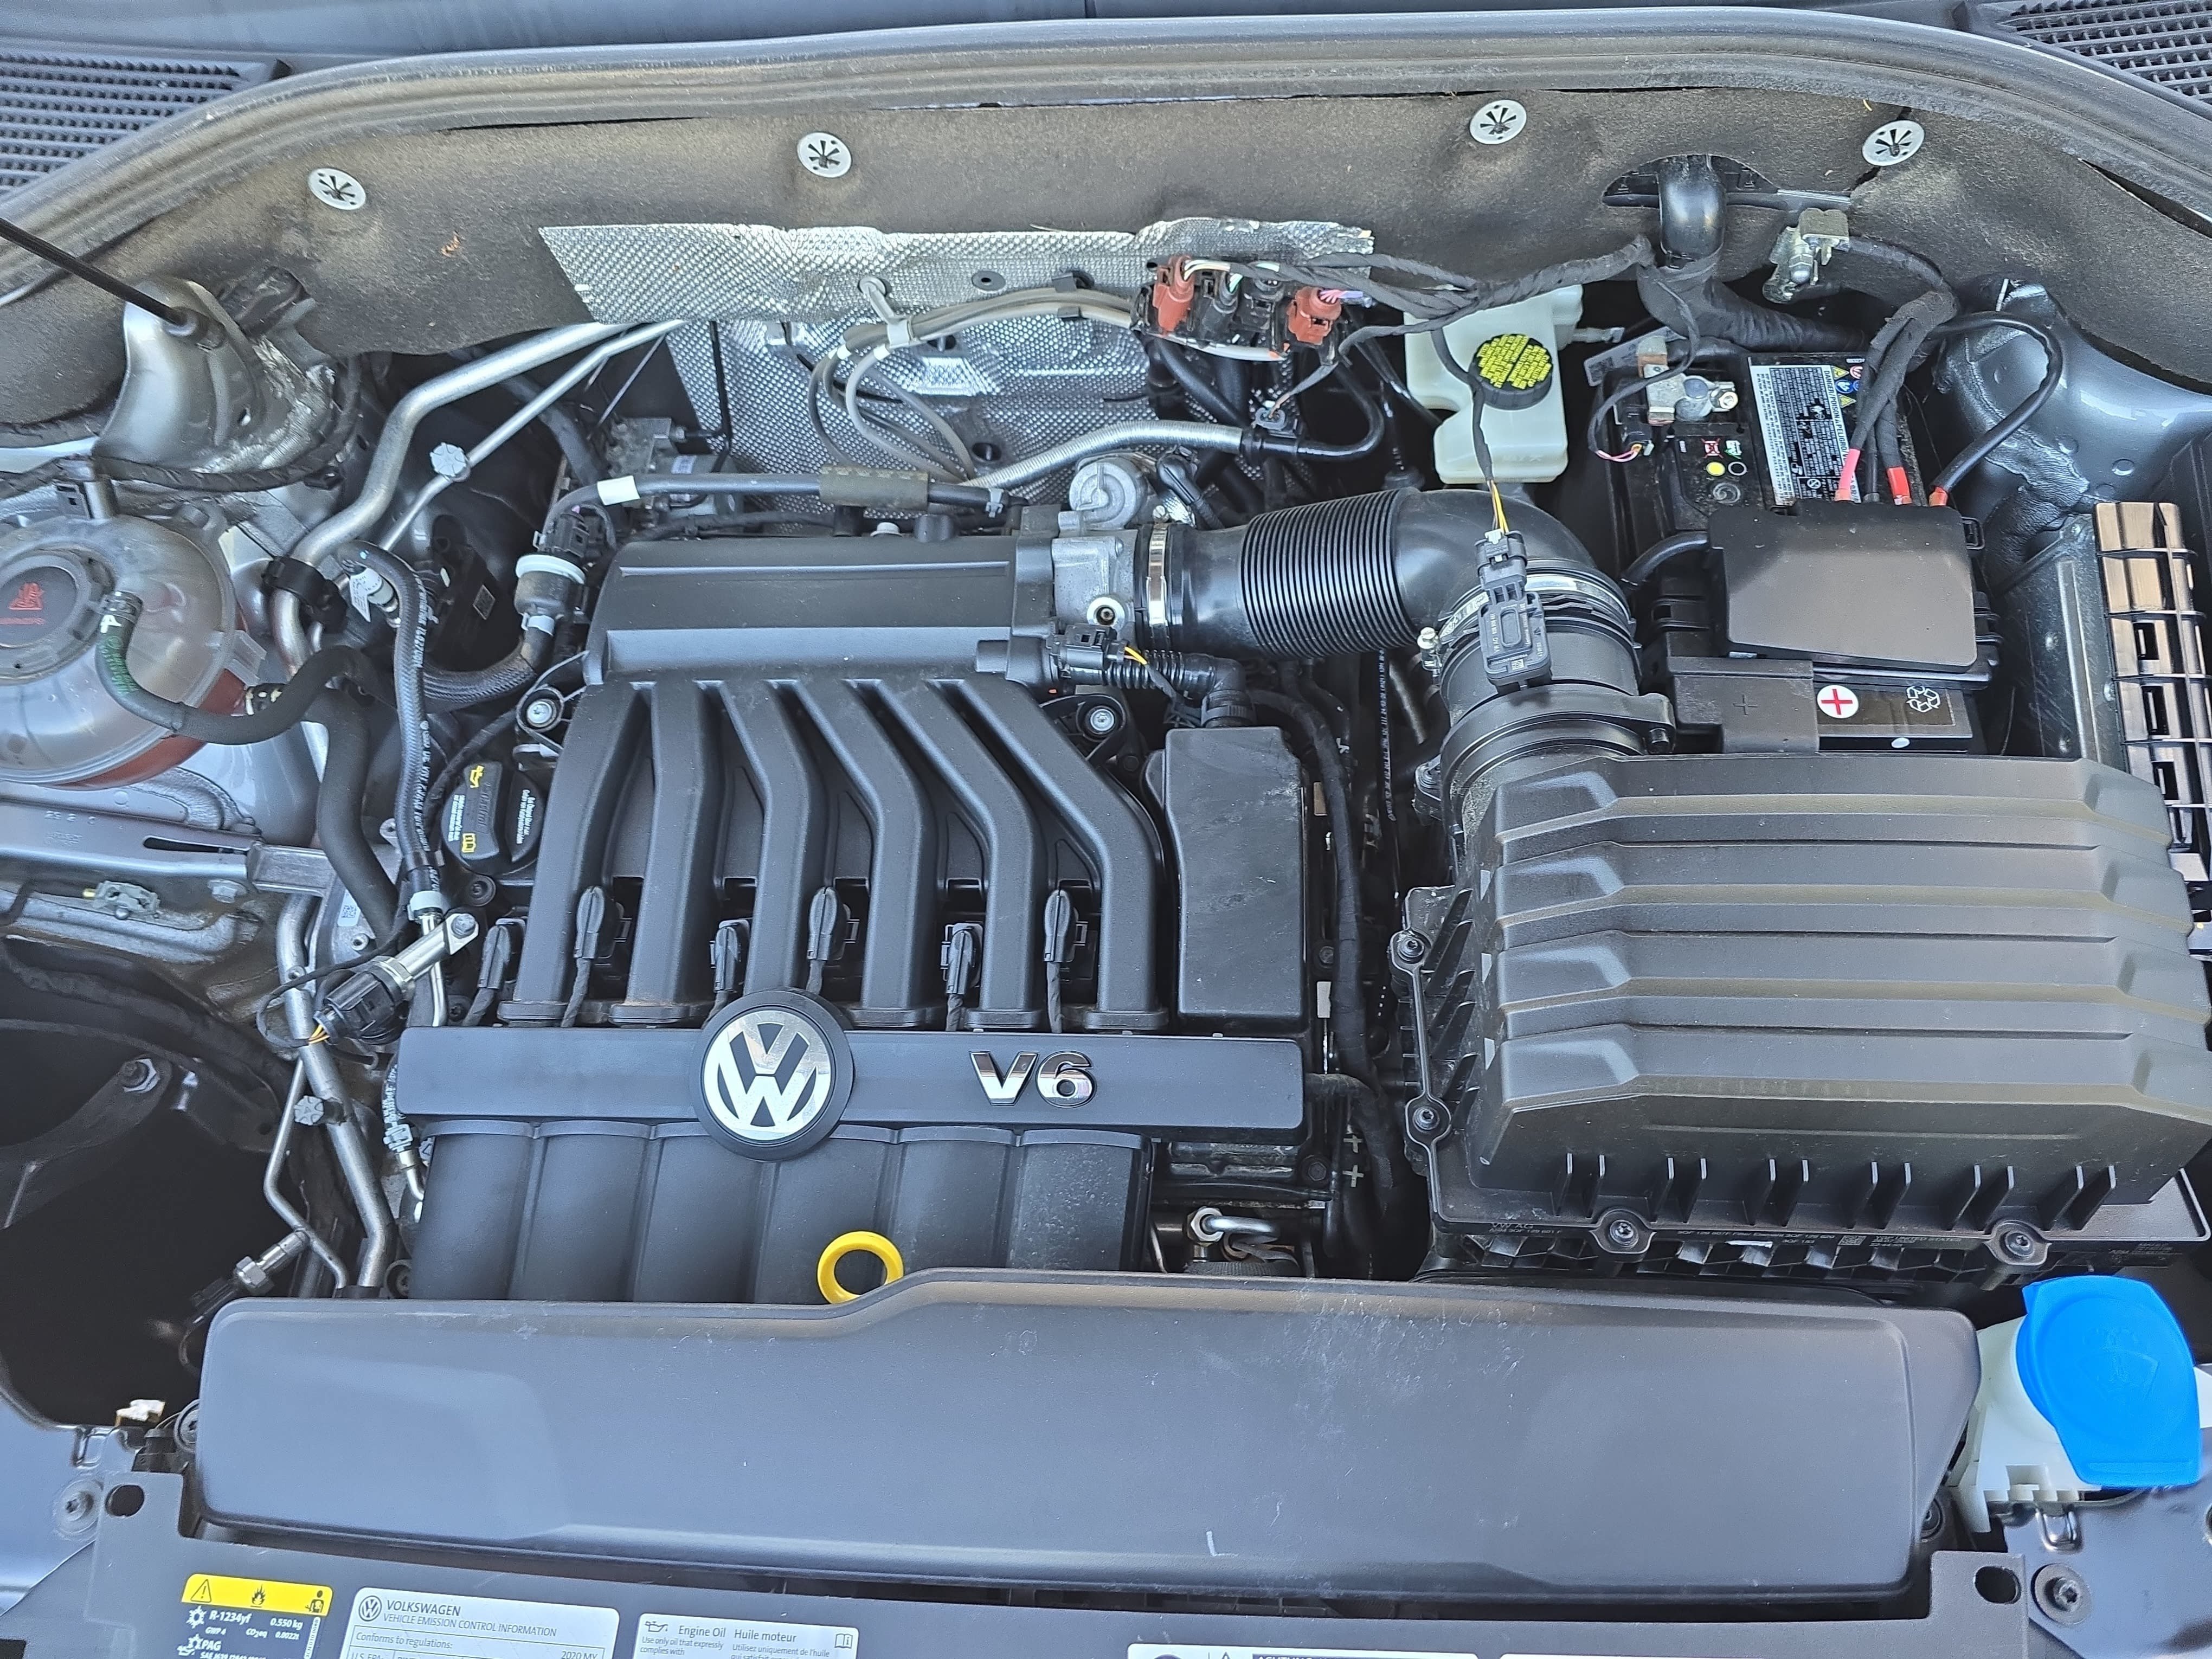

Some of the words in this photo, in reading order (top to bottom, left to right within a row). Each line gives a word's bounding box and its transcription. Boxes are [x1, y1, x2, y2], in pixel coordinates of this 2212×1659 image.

[969, 1051, 1096, 1108] V6
[387, 1599, 461, 1617] VOLKSWAGEN
[209, 1610, 252, 1625] R-1234yf
[270, 1618, 293, 1628] 0.550
[292, 1619, 303, 1631] kg
[383, 1613, 416, 1624] VEHICLE
[417, 1616, 456, 1628] EMISSION
[458, 1619, 496, 1632] CONTROL
[498, 1623, 557, 1637] INFORMATION
[678, 1625, 710, 1638] Engine
[712, 1627, 726, 1637] Oil
[356, 1632, 394, 1643] Conforms
[396, 1636, 404, 1644] to
[406, 1638, 453, 1649] regulations:
[734, 1629, 759, 1640] Huile
[761, 1632, 797, 1643] moteur
[201, 1639, 222, 1651] PAG
[640, 1646, 668, 1655] complies
[655, 1637, 670, 1647] only
[694, 1641, 724, 1651] expressly
[732, 1643, 757, 1652] Utilisez
[758, 1645, 799, 1655] uniquement
[561, 1651, 582, 1659] 2020
